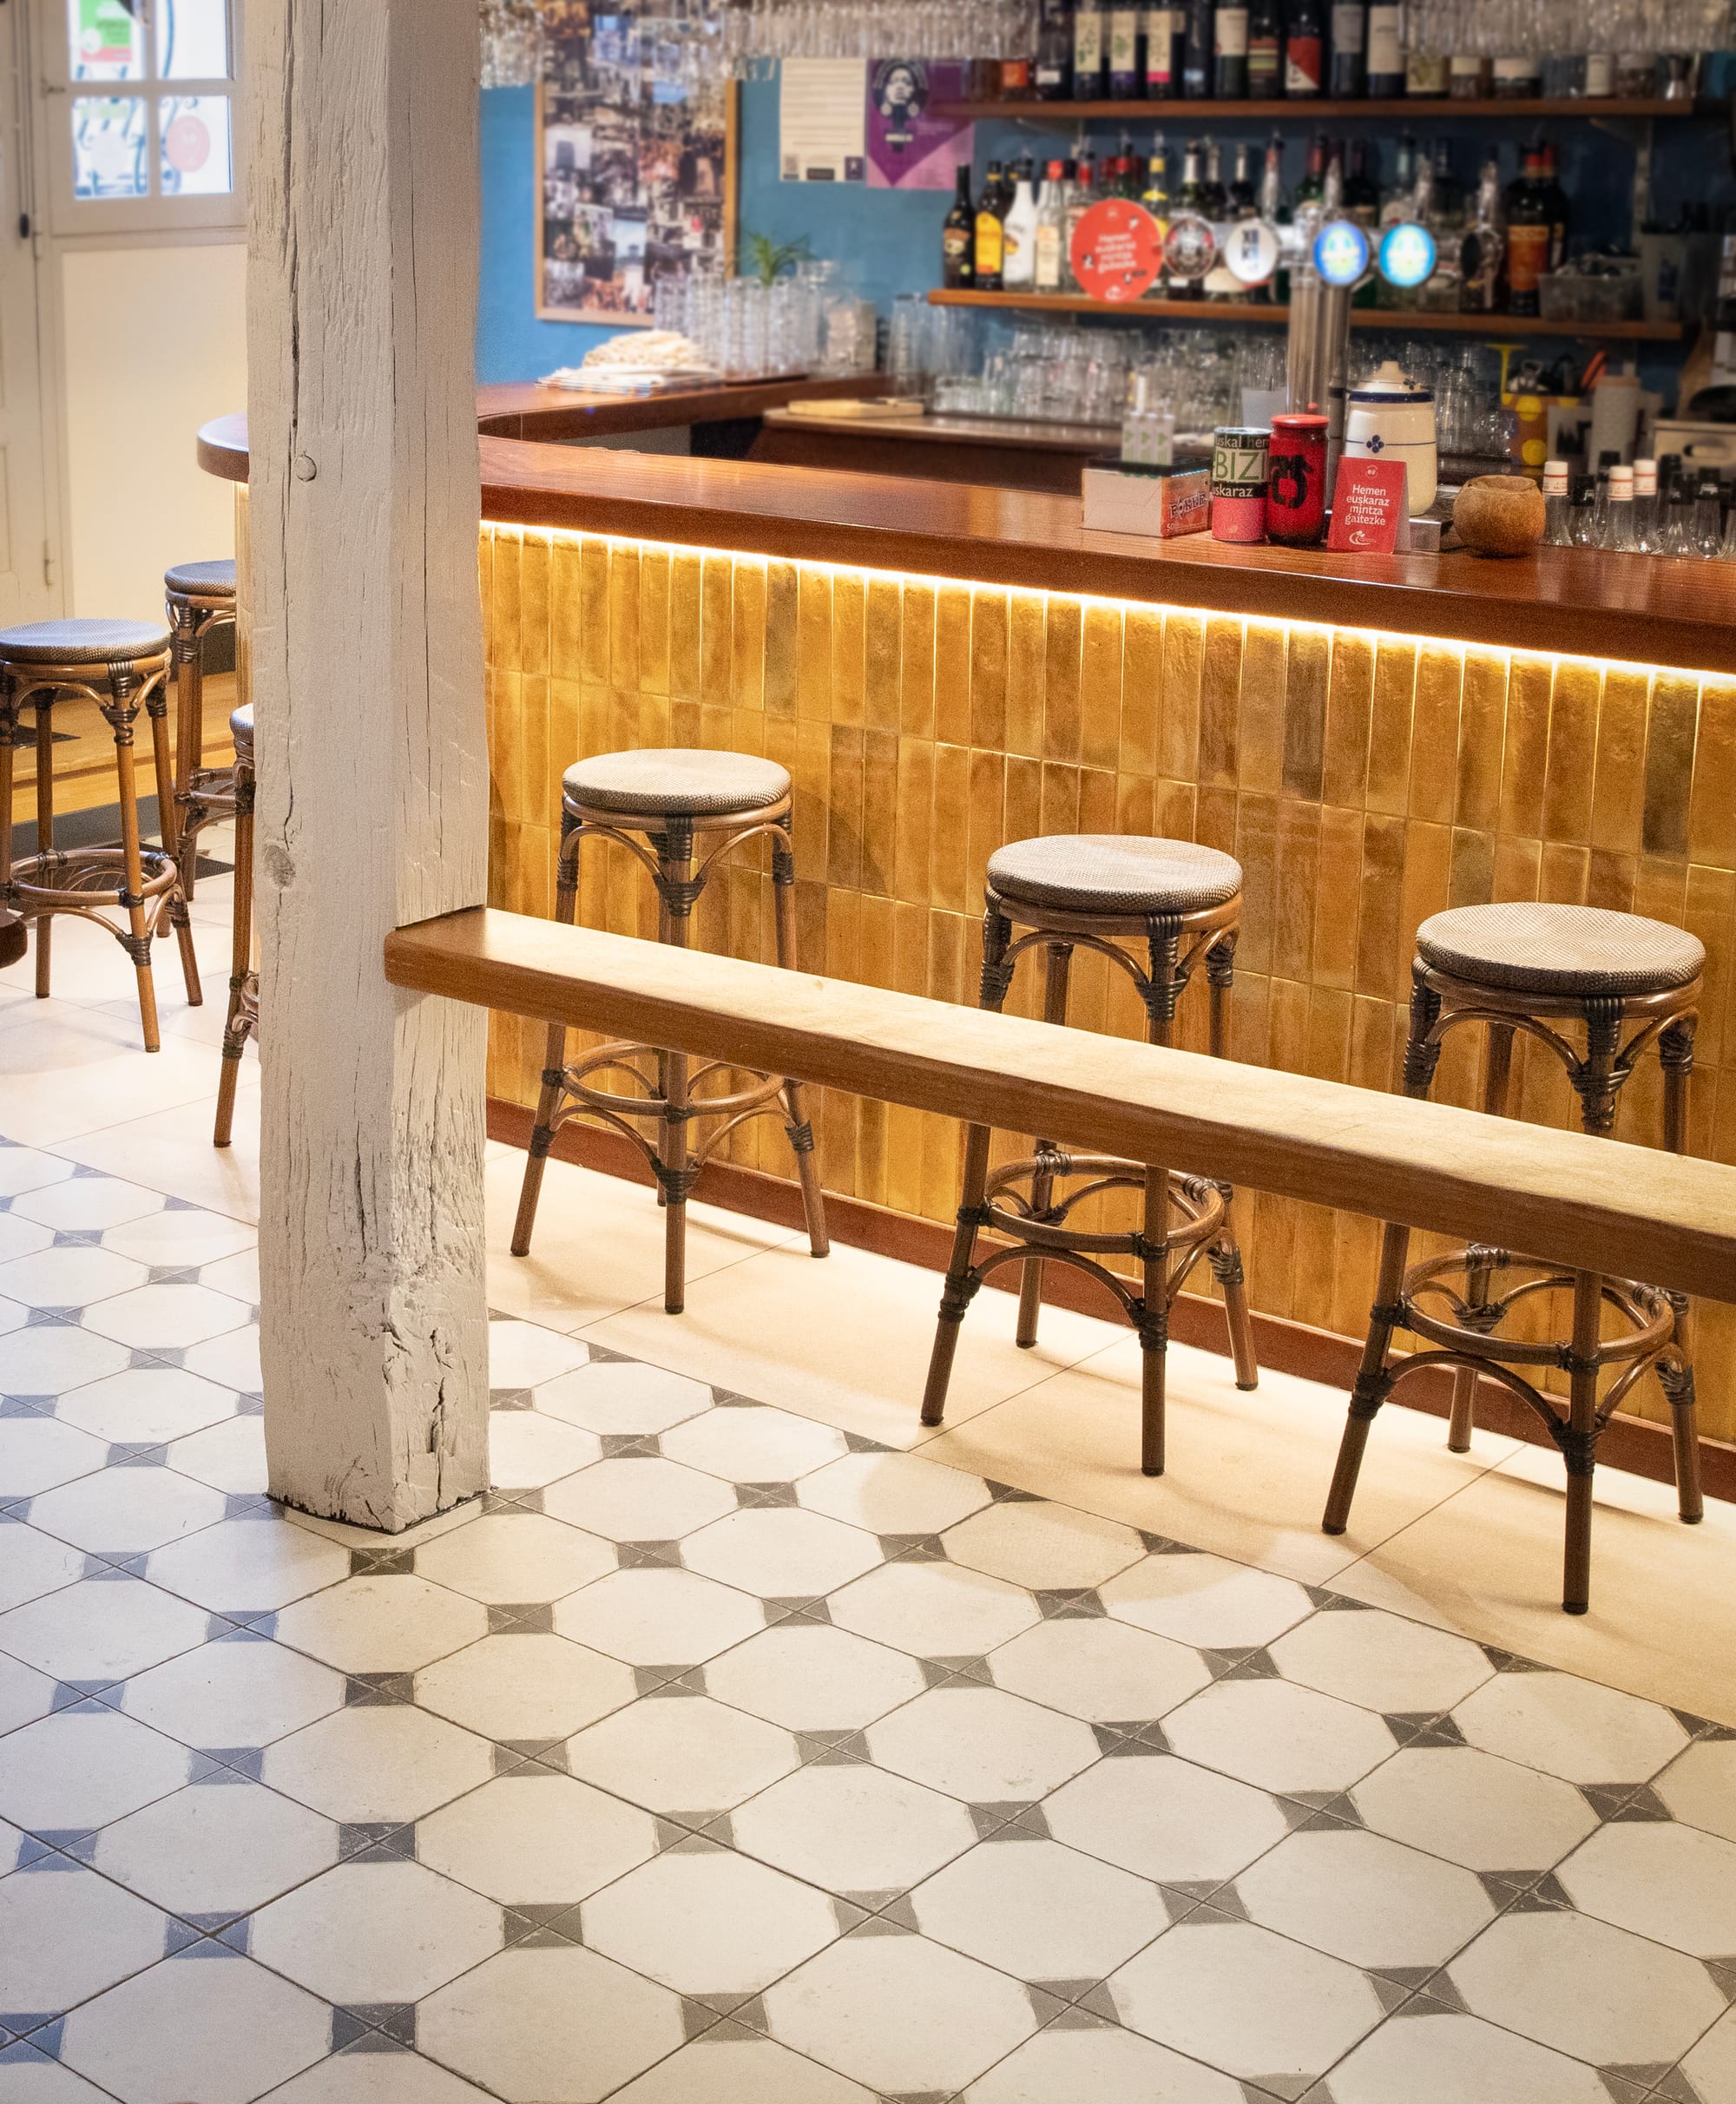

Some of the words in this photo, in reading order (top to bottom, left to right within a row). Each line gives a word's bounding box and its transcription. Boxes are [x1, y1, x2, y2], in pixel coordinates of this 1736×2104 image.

[1352, 484, 1386, 496] Hemen
[1346, 495, 1390, 506] euskaraz
[1350, 504, 1383, 516] mintza
[1345, 514, 1386, 525] gaitezke
